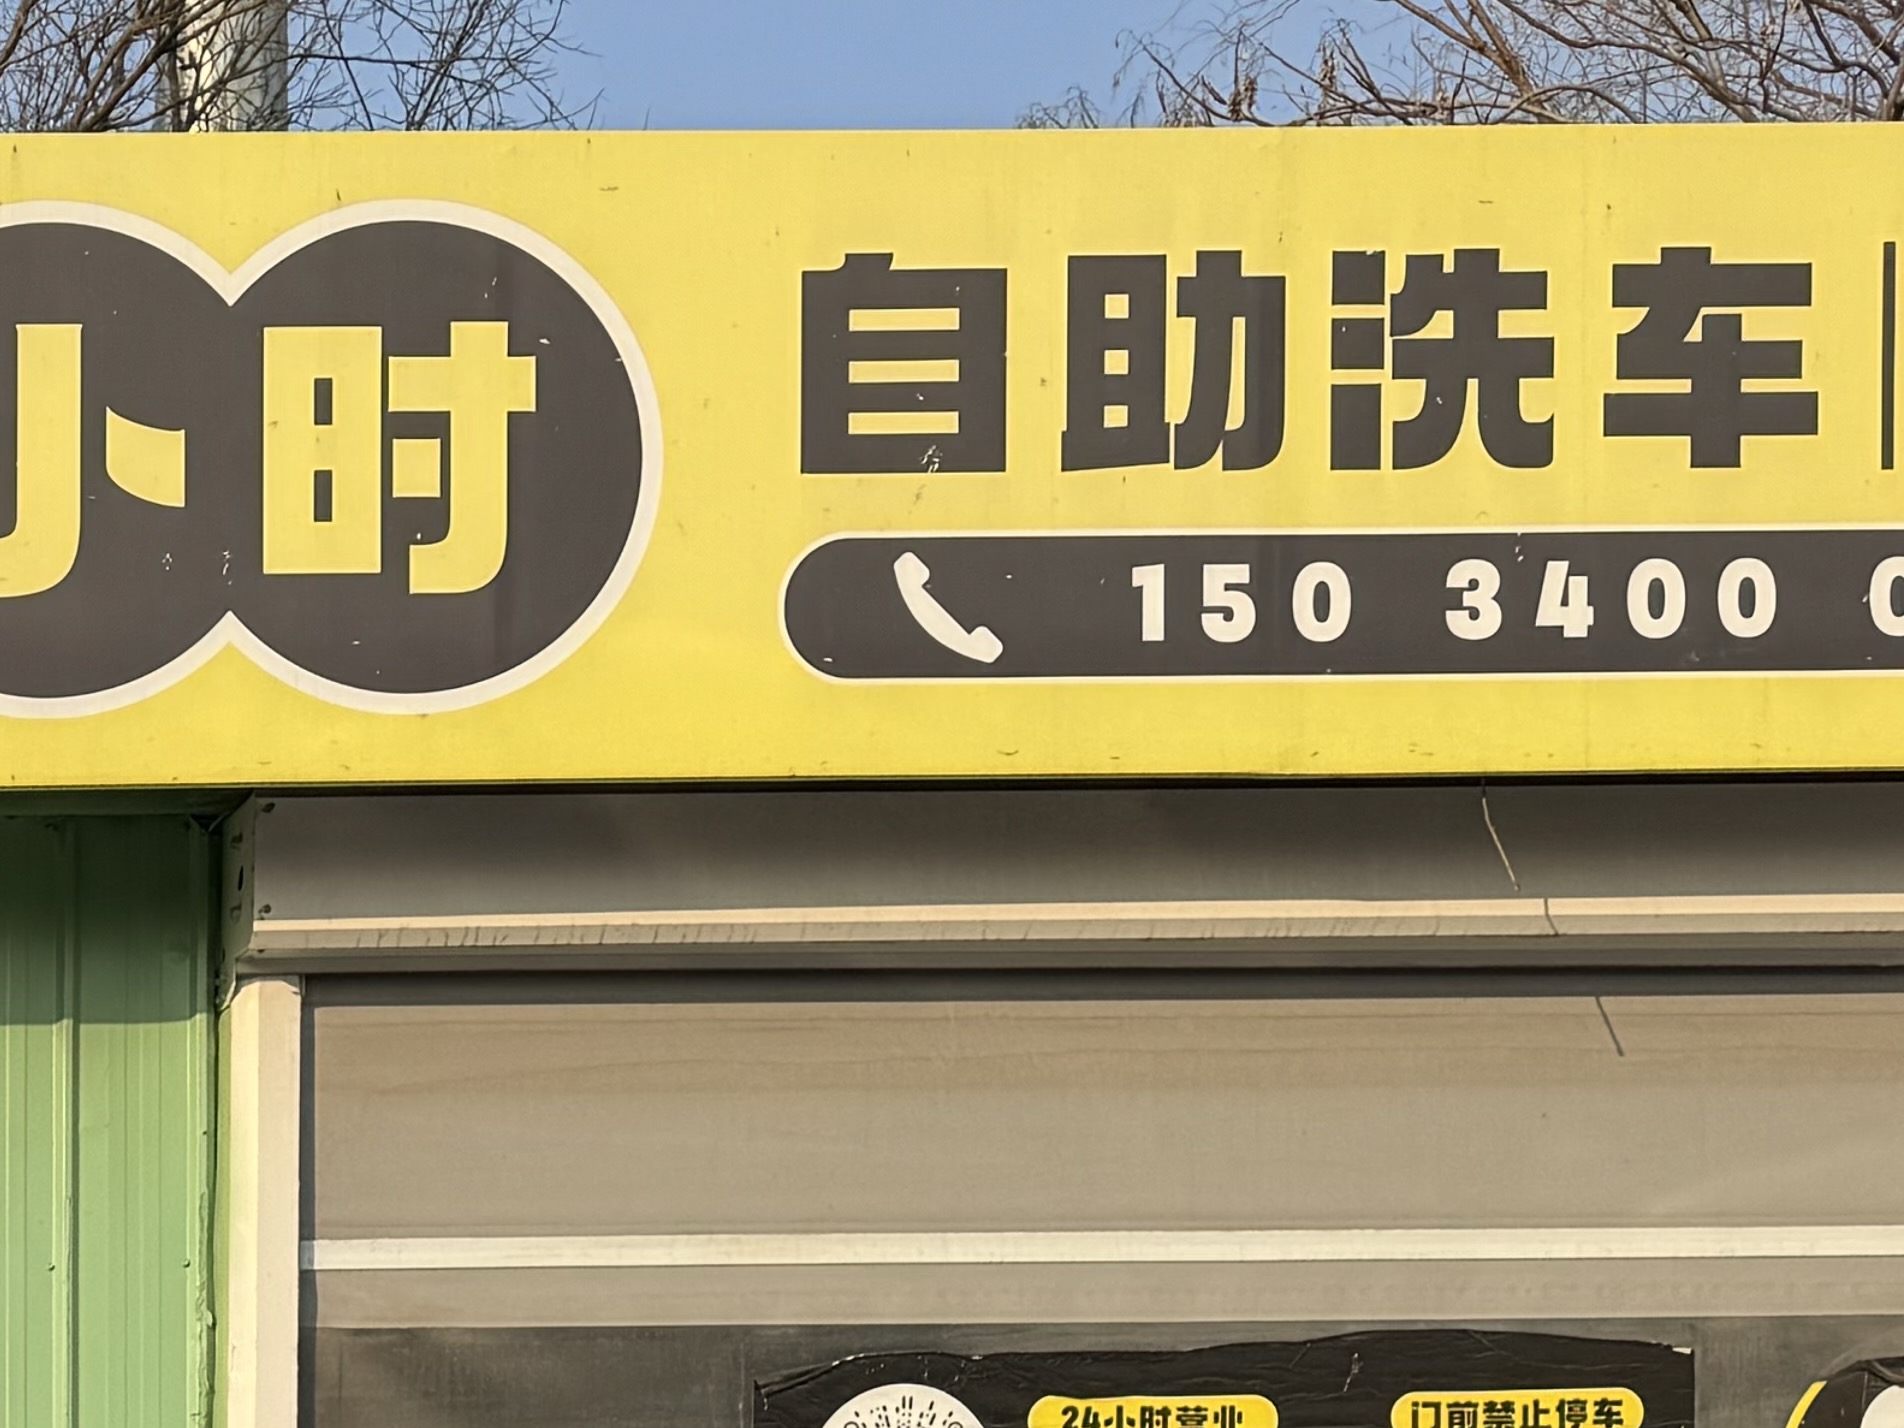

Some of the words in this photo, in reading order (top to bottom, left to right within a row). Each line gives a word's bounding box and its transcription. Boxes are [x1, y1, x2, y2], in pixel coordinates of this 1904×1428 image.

[800, 247, 1820, 475] 自助洗车
[1131, 561, 1353, 643] 150
[1445, 557, 1778, 641] 3400
